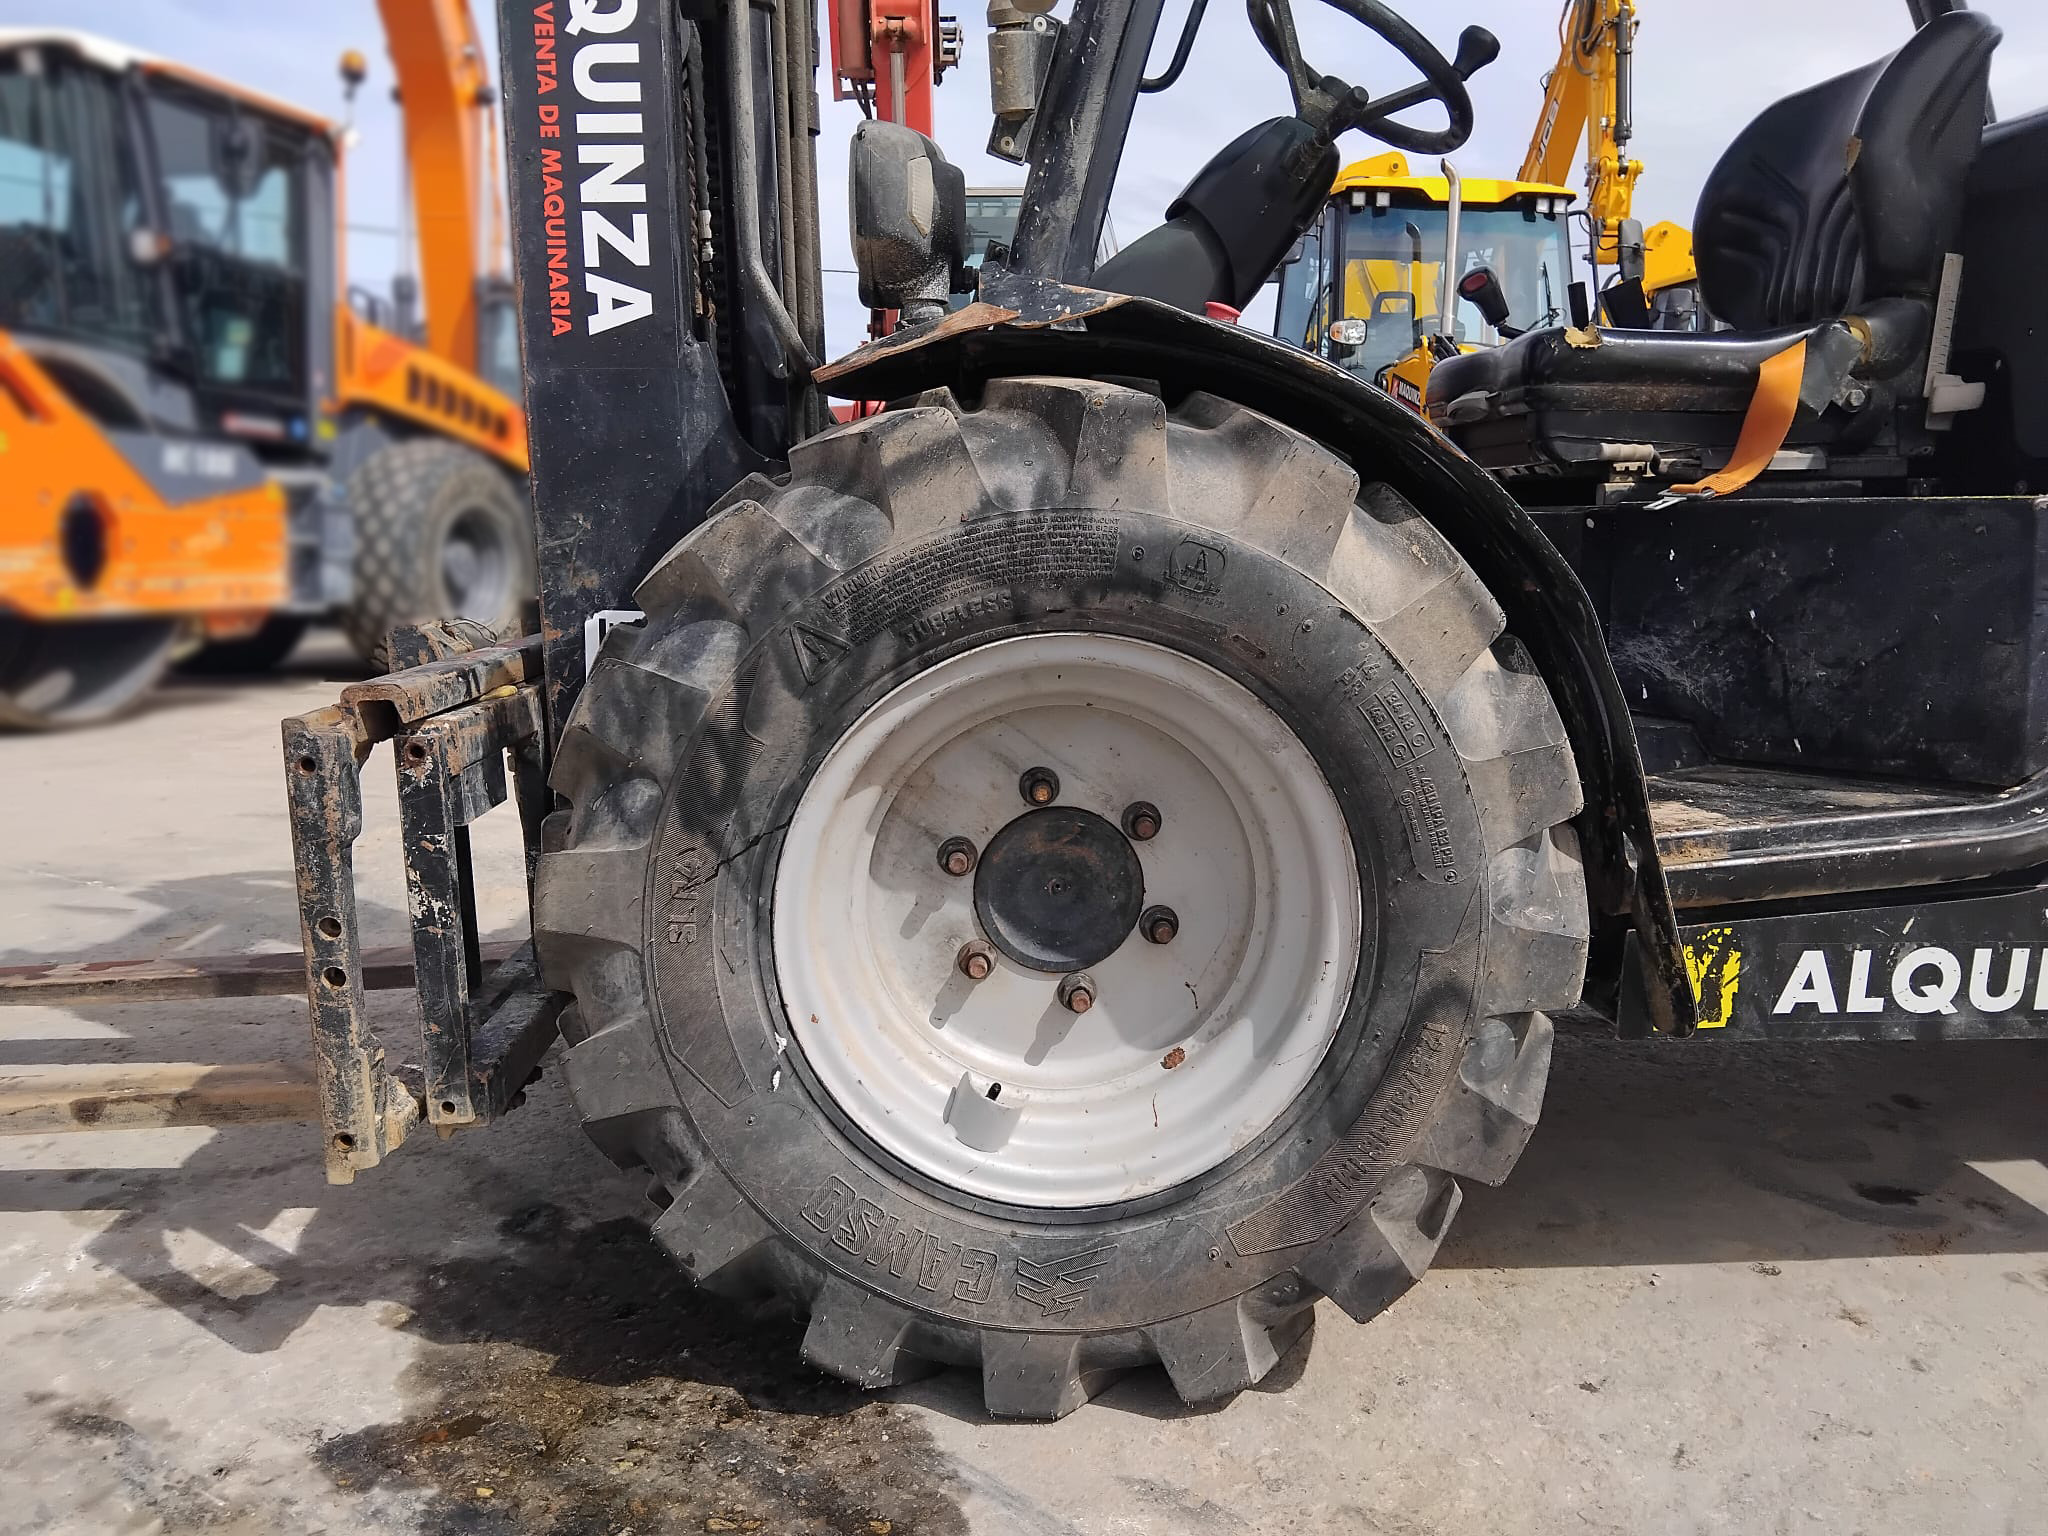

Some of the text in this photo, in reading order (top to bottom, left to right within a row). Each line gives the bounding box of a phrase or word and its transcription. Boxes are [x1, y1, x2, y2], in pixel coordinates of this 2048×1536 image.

[533, 1, 572, 337] VENTA DE MAQUINARIA
[1536, 98, 1560, 165] JCB
[801, 1174, 999, 1304] CAMSO
